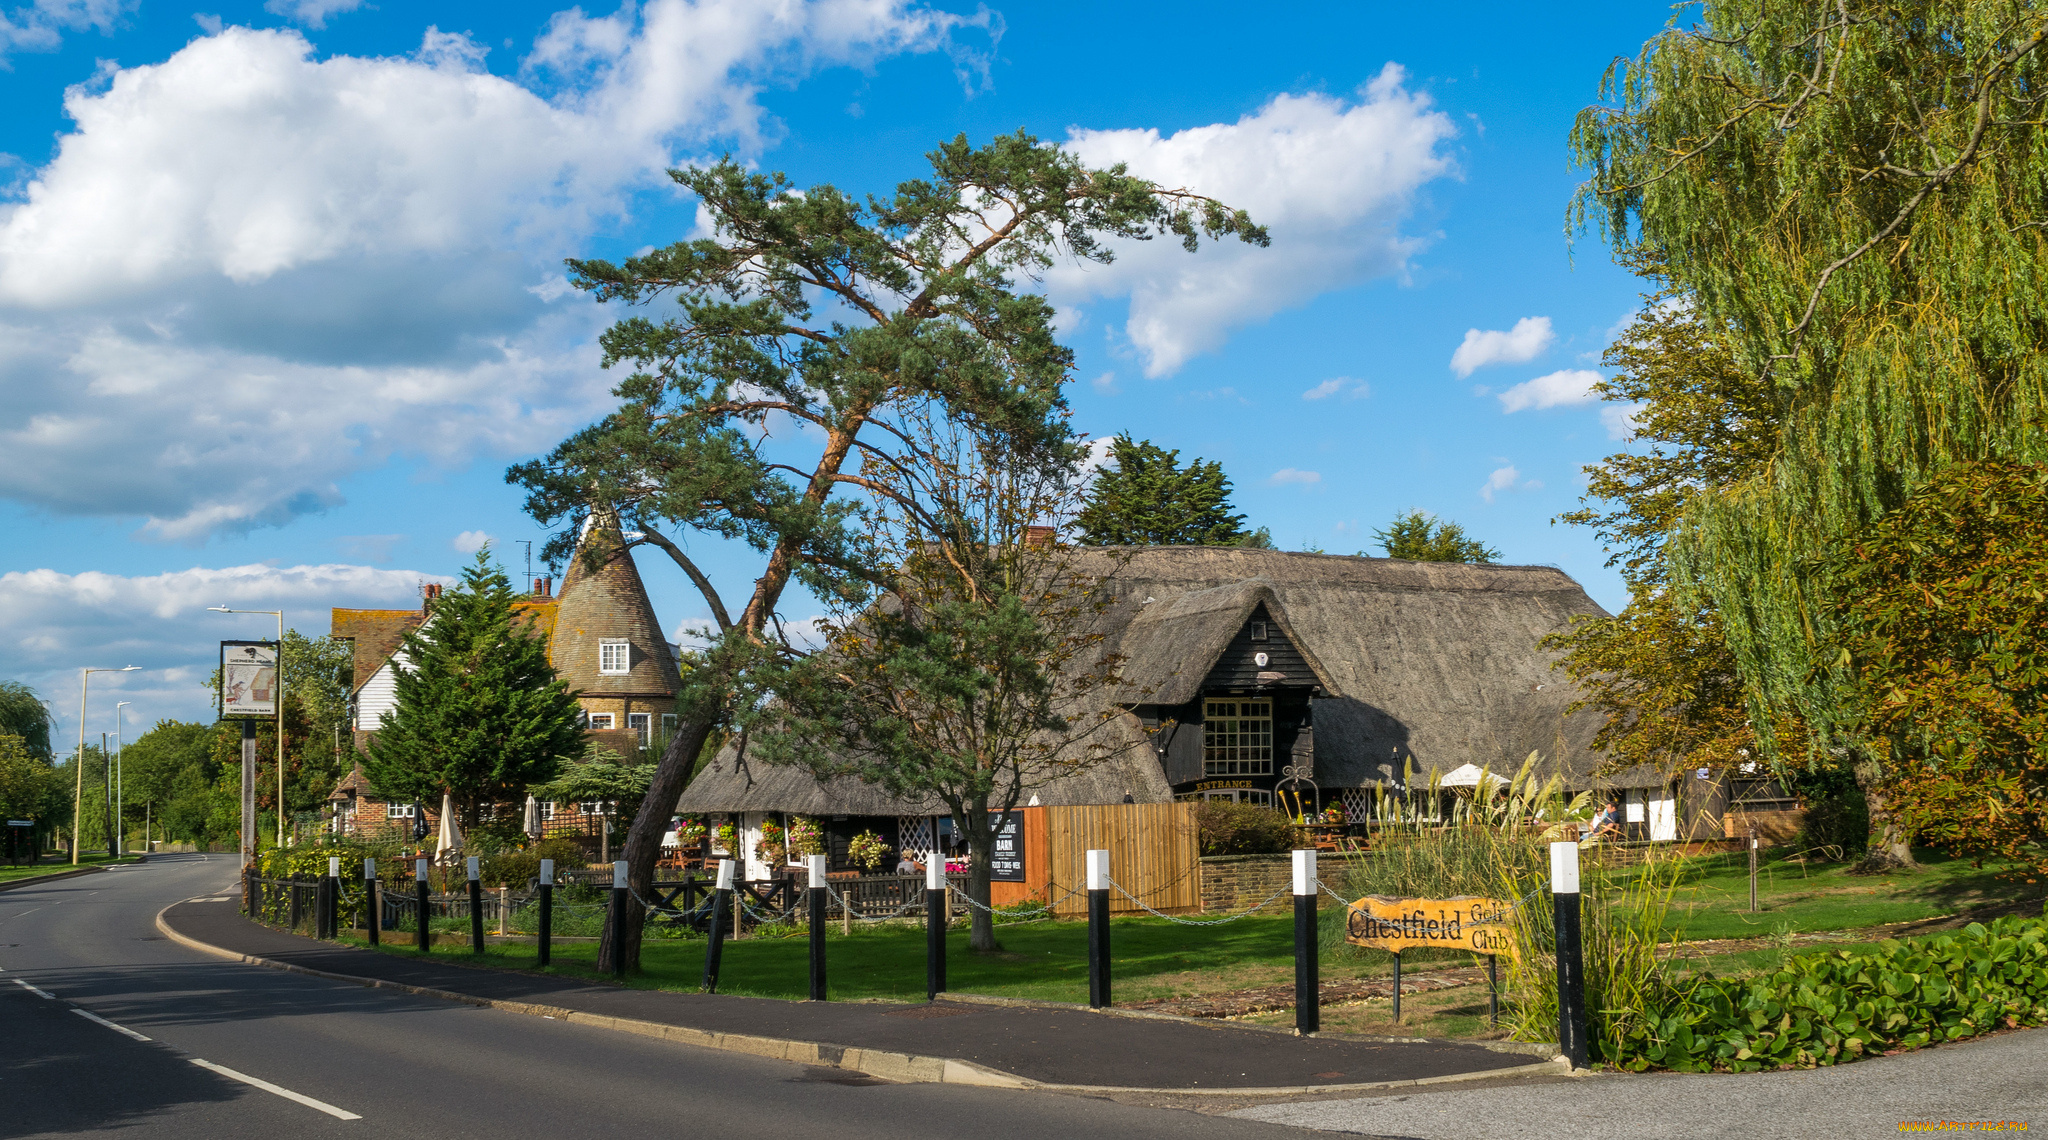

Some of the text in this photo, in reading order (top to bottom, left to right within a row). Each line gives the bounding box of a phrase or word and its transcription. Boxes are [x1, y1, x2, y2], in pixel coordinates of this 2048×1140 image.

[1196, 780, 1252, 792] ENTRANCE
[996, 840, 1012, 850] BARN
[1349, 909, 1462, 940] Chestfield
[1472, 929, 1508, 949] Club
